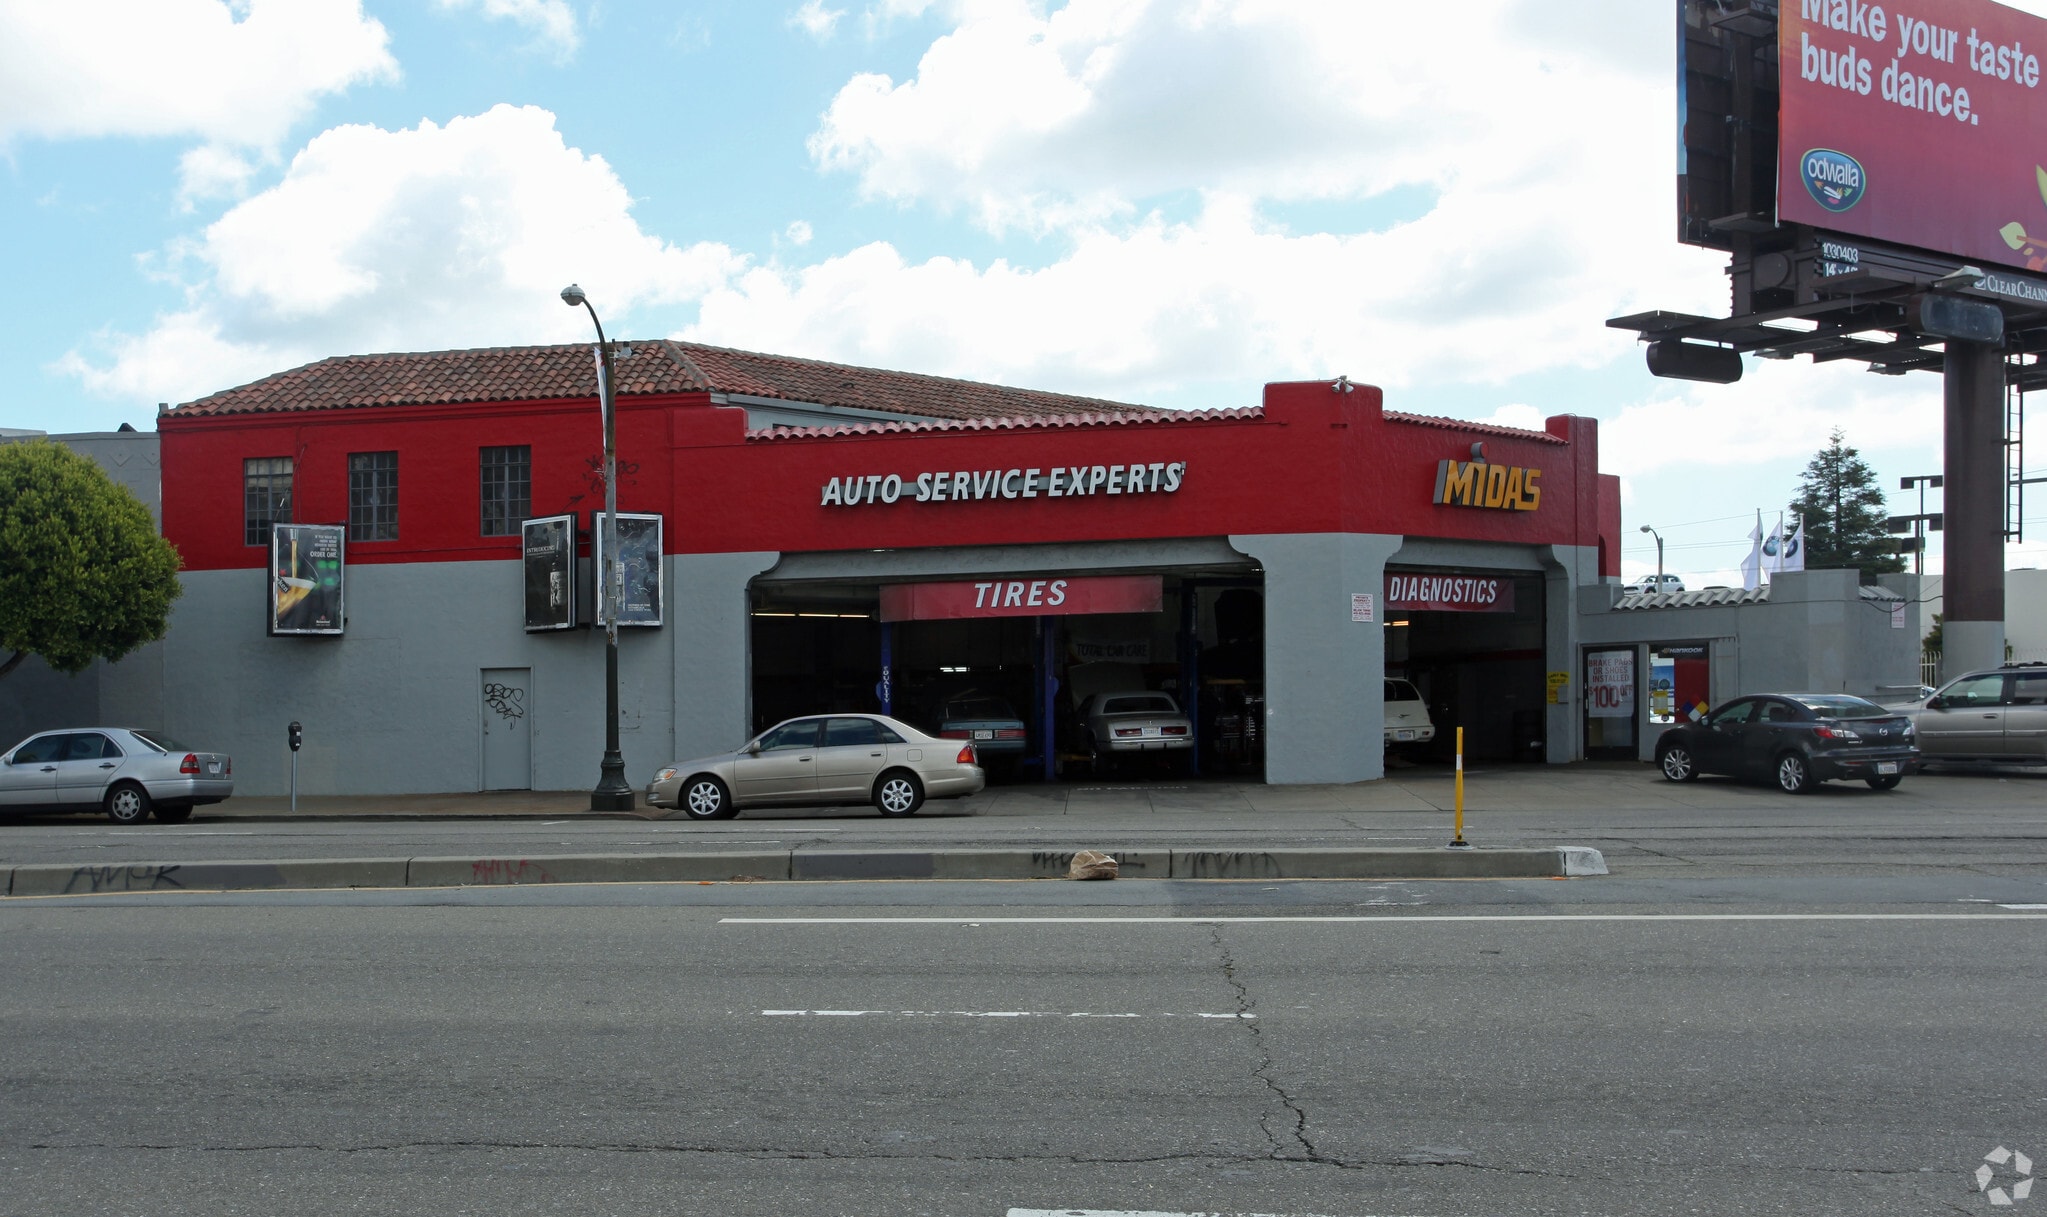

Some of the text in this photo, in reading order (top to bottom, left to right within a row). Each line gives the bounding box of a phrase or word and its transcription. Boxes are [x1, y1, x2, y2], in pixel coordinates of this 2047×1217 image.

[1801, 0, 2039, 88] Make your taste
[1801, 32, 1978, 125] buds dance.
[1808, 157, 1859, 187] odwalla
[1823, 242, 1859, 263] 1030403
[821, 463, 1182, 505] AUTO SERVICE EXPERTS
[1438, 459, 1542, 511] MIDAS
[975, 580, 1068, 608] TIRES
[1390, 577, 1497, 603] DIAGNOSTICS
[1589, 659, 1612, 667] BRAKE
[1593, 667, 1603, 675] OR
[1620, 685, 1633, 697] OFF
